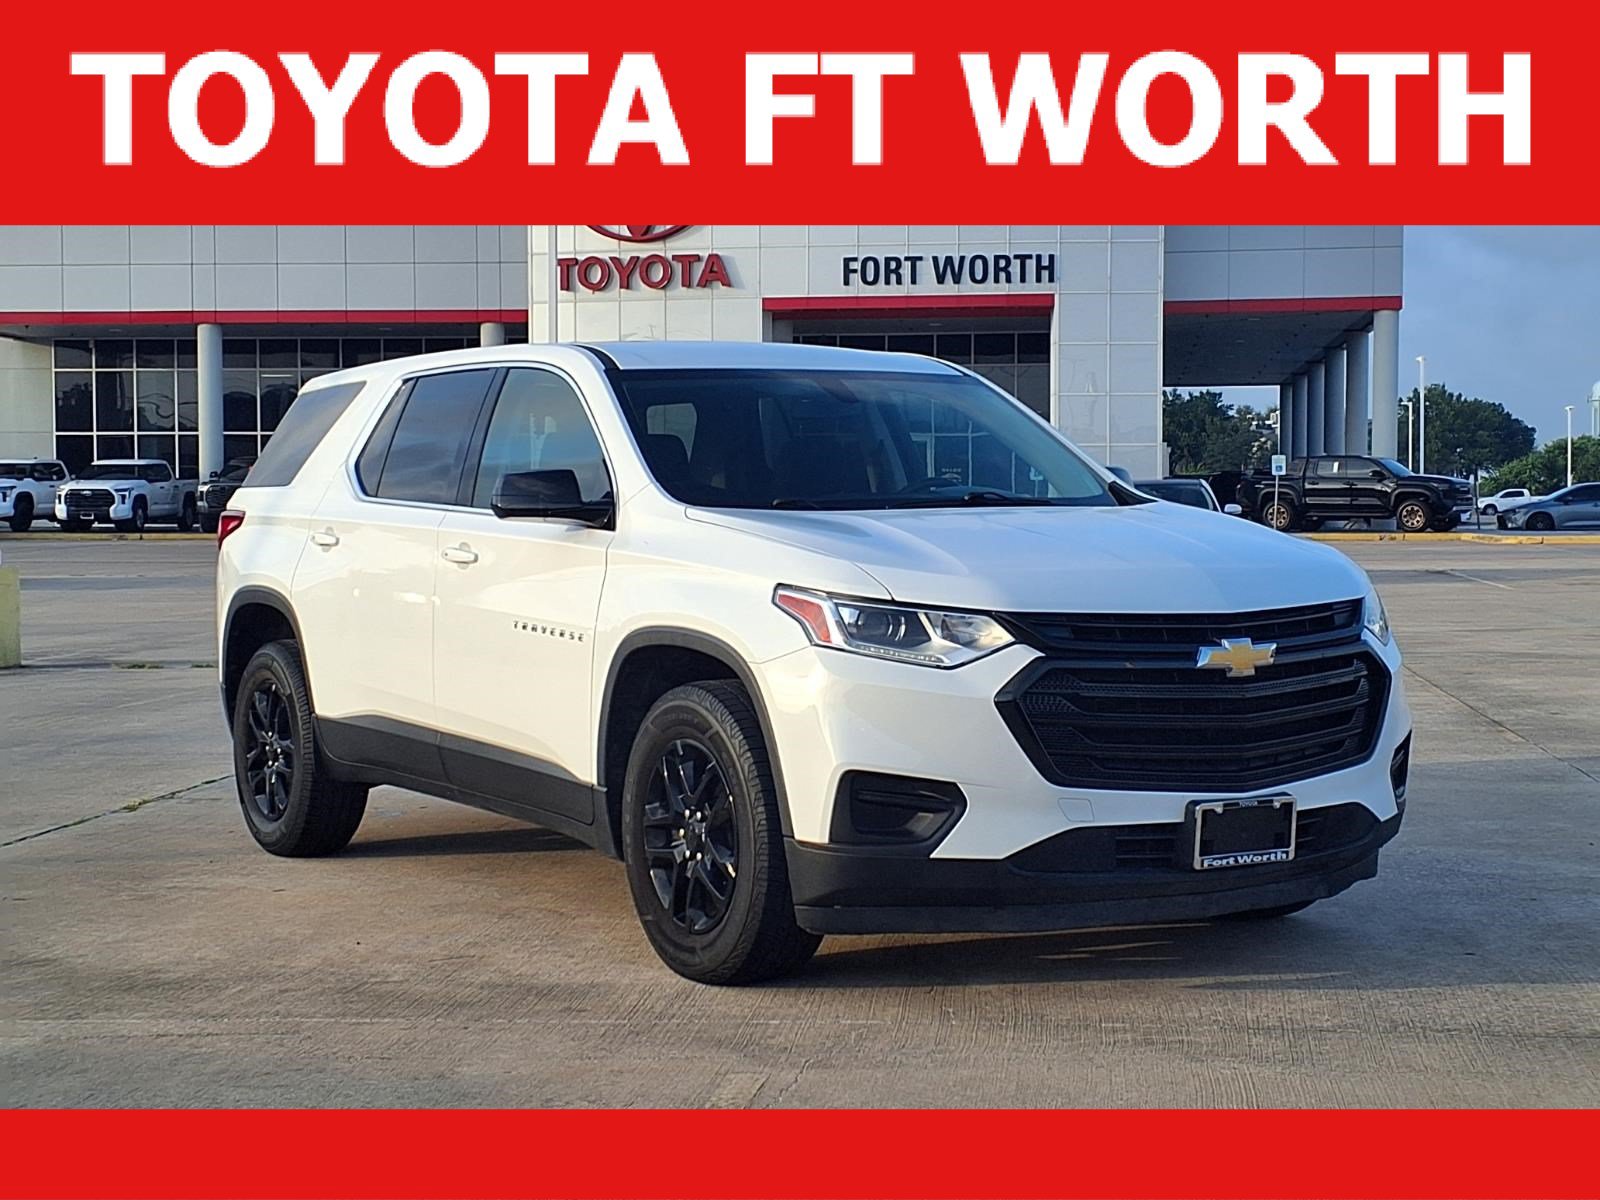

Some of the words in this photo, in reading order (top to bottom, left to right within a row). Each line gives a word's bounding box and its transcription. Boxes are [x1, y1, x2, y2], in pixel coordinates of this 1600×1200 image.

[557, 253, 732, 292] TOYOTA
[843, 255, 923, 287] FORT
[931, 253, 1057, 286] WORTH
[513, 620, 585, 642] TRAVERSE
[1203, 857, 1235, 868] Fort
[1237, 851, 1287, 864] Worth
